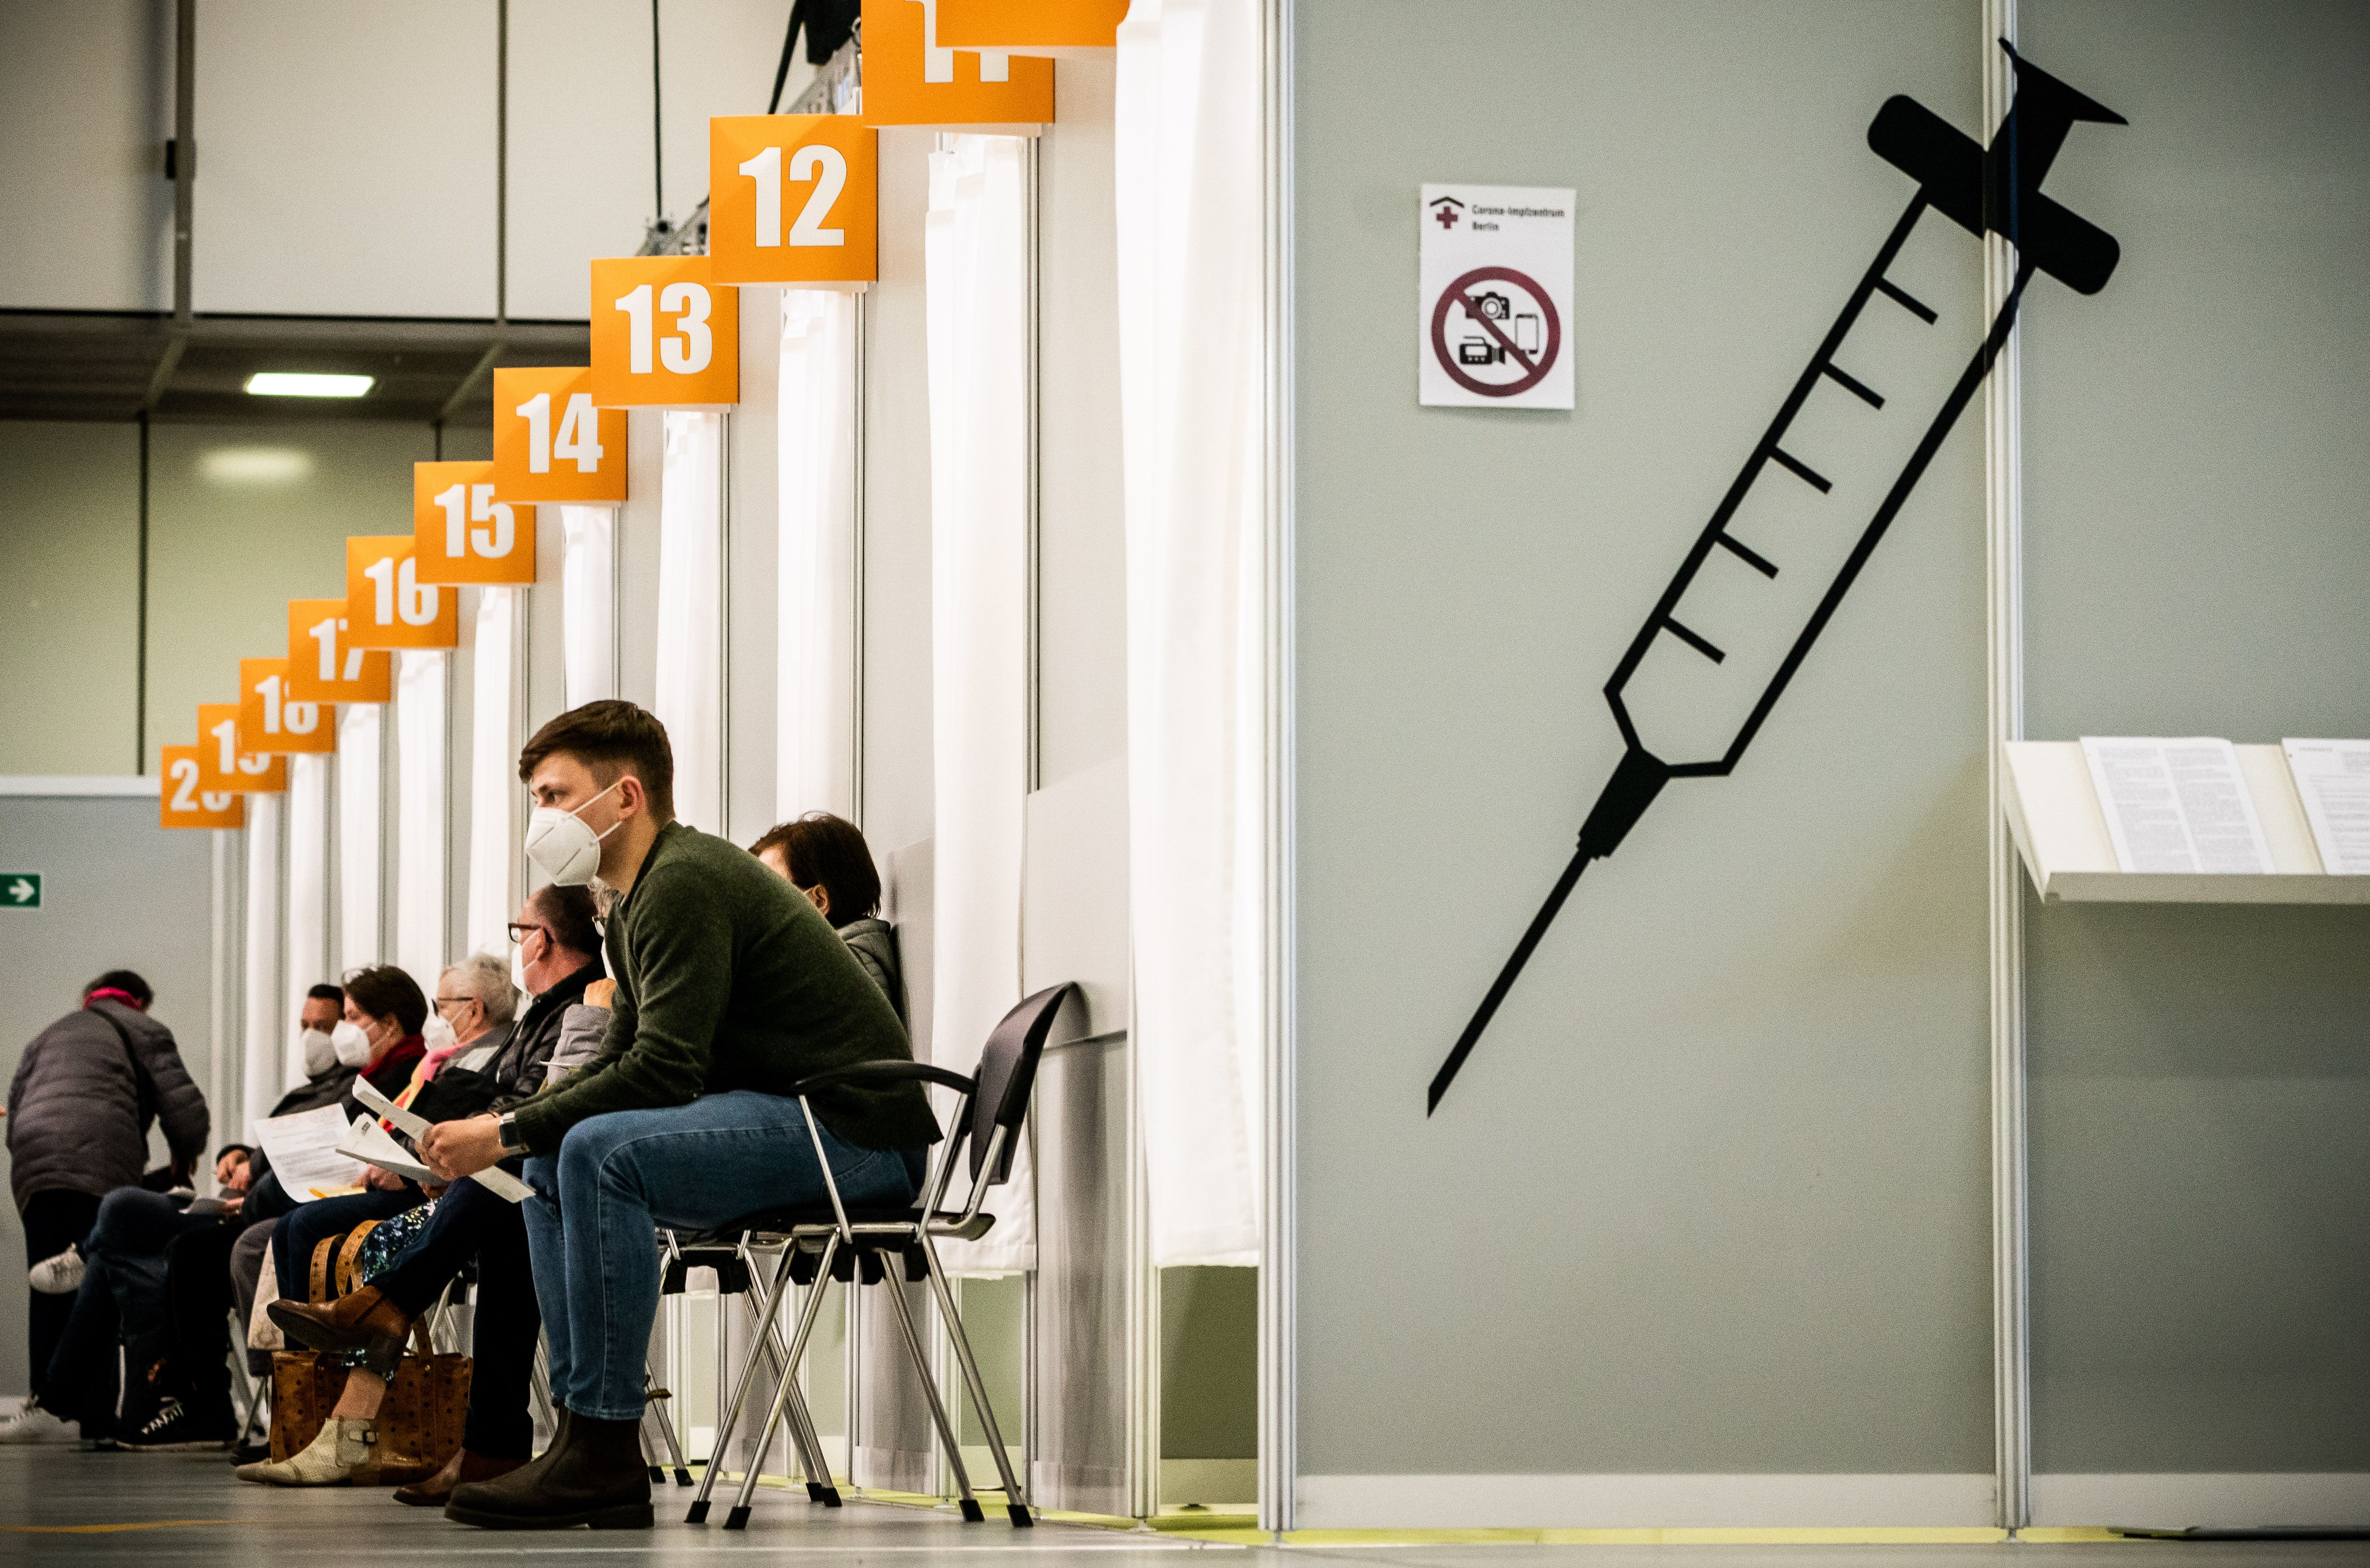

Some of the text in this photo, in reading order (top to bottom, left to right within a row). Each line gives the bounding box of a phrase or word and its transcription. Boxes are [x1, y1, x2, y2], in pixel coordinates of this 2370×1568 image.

[738, 144, 848, 247] 12
[1472, 221, 1500, 231] Berlin
[615, 282, 713, 374] 13
[516, 393, 604, 473] 14
[434, 483, 515, 559] 15
[364, 557, 439, 626] 16
